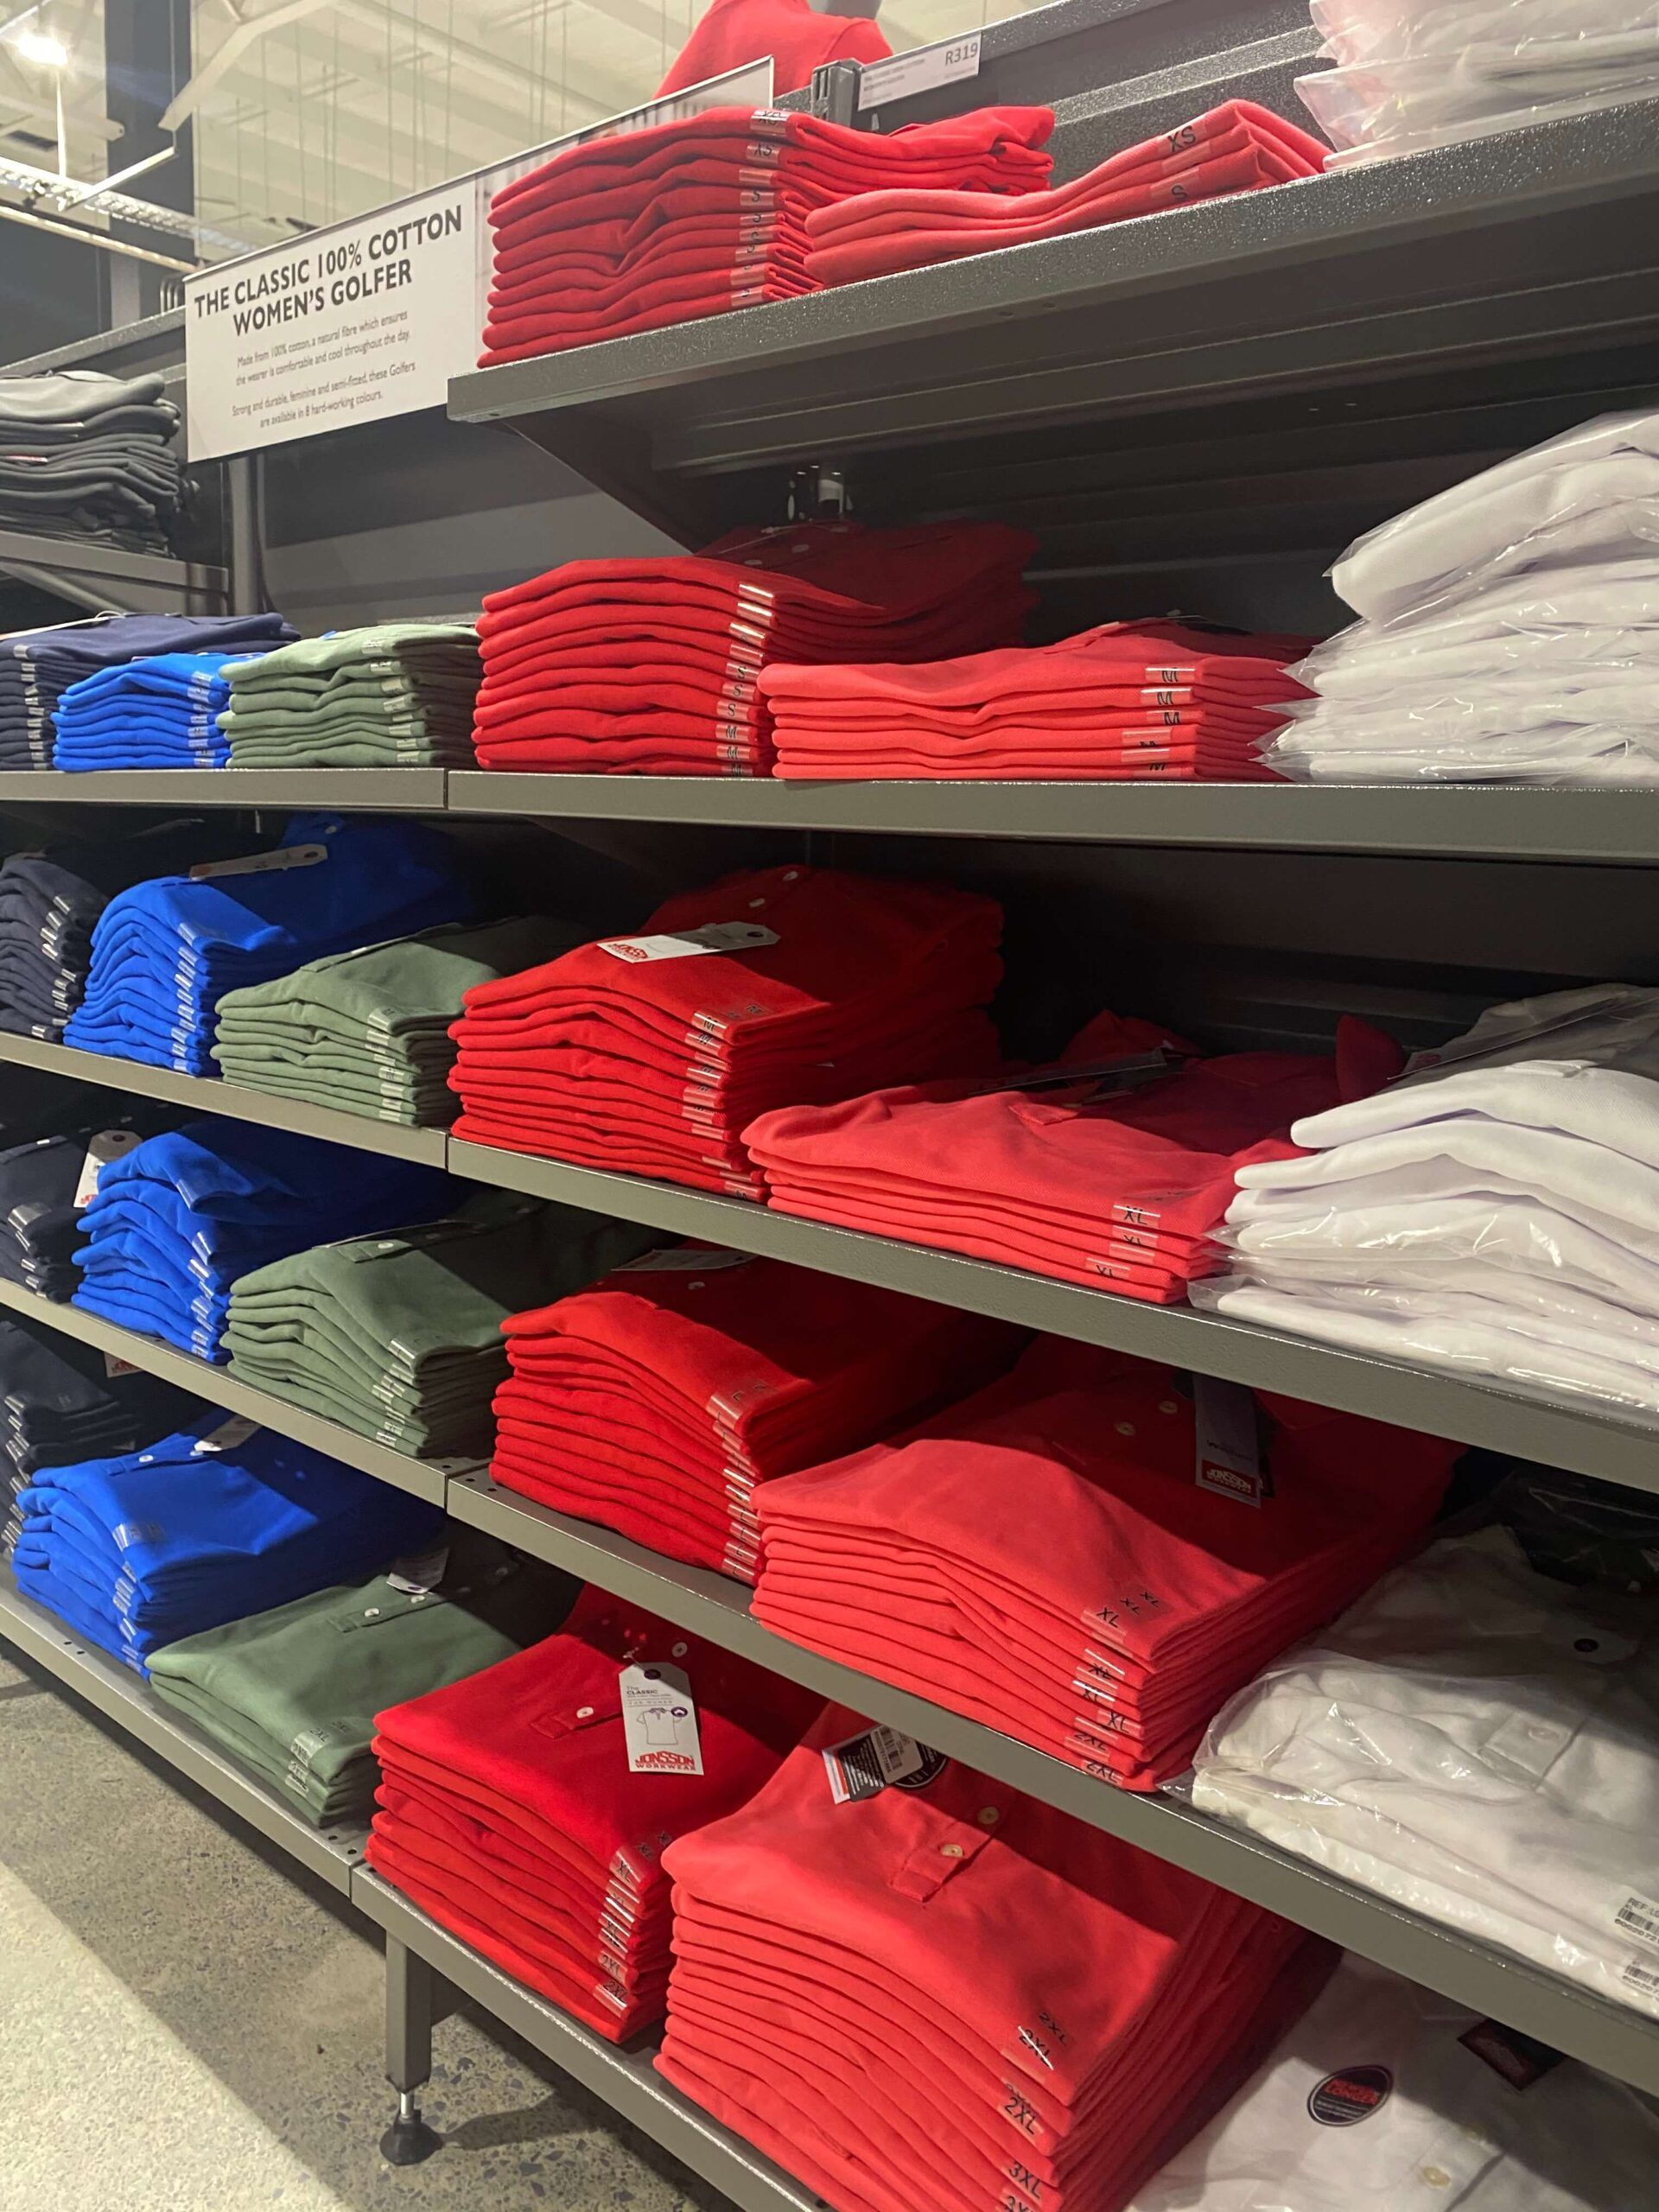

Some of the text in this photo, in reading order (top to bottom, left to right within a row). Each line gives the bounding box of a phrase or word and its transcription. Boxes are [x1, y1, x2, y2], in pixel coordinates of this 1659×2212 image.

[945, 42, 979, 66] R319
[1167, 125, 1196, 152] XS
[1172, 184, 1188, 199] S
[194, 204, 461, 319] THE CLASSIC 100% COTTON
[233, 258, 412, 336] WOMEN'S GOLFER
[237, 355, 253, 368] Made
[254, 351, 270, 362] from
[271, 343, 287, 358] 100%
[317, 327, 340, 344] natural
[341, 325, 357, 338] fibre
[359, 316, 379, 332] which
[380, 310, 408, 327] ensures
[236, 375, 246, 386] the
[247, 370, 268, 382] wearer
[276, 355, 314, 375] comfortable
[315, 351, 327, 363] and
[327, 346, 343, 361] cool
[344, 338, 383, 356] throughout
[384, 332, 396, 346] the
[397, 328, 410, 344] day.
[232, 404, 252, 416] Strong
[252, 397, 264, 411] and
[289, 388, 316, 402] feminine
[317, 380, 330, 395] and
[368, 369, 388, 382] these
[389, 360, 416, 377] Golfers
[260, 390, 383, 429] are available in 8 hard-working colours.
[737, 665, 747, 679] S
[1161, 667, 1179, 683] M
[734, 683, 743, 697] S
[1157, 691, 1173, 706] M
[727, 703, 736, 717] S
[1163, 711, 1181, 726] M
[1124, 1205, 1147, 1225] XL
[1119, 1598, 1141, 1615] XL
[1141, 1592, 1160, 1608] XL
[1096, 1606, 1119, 1628] XL
[1108, 1712, 1129, 1733] XL
[635, 1751, 695, 1766] JONSSON
[635, 1763, 696, 1771] WORKWEAR
[1086, 1762, 1118, 1783] 2XL
[1039, 2012, 1066, 2047] 2XL
[1019, 2029, 1051, 2068] 2XL
[1004, 2096, 1034, 2135] 2XL
[1008, 2161, 1040, 2199] 3XL
